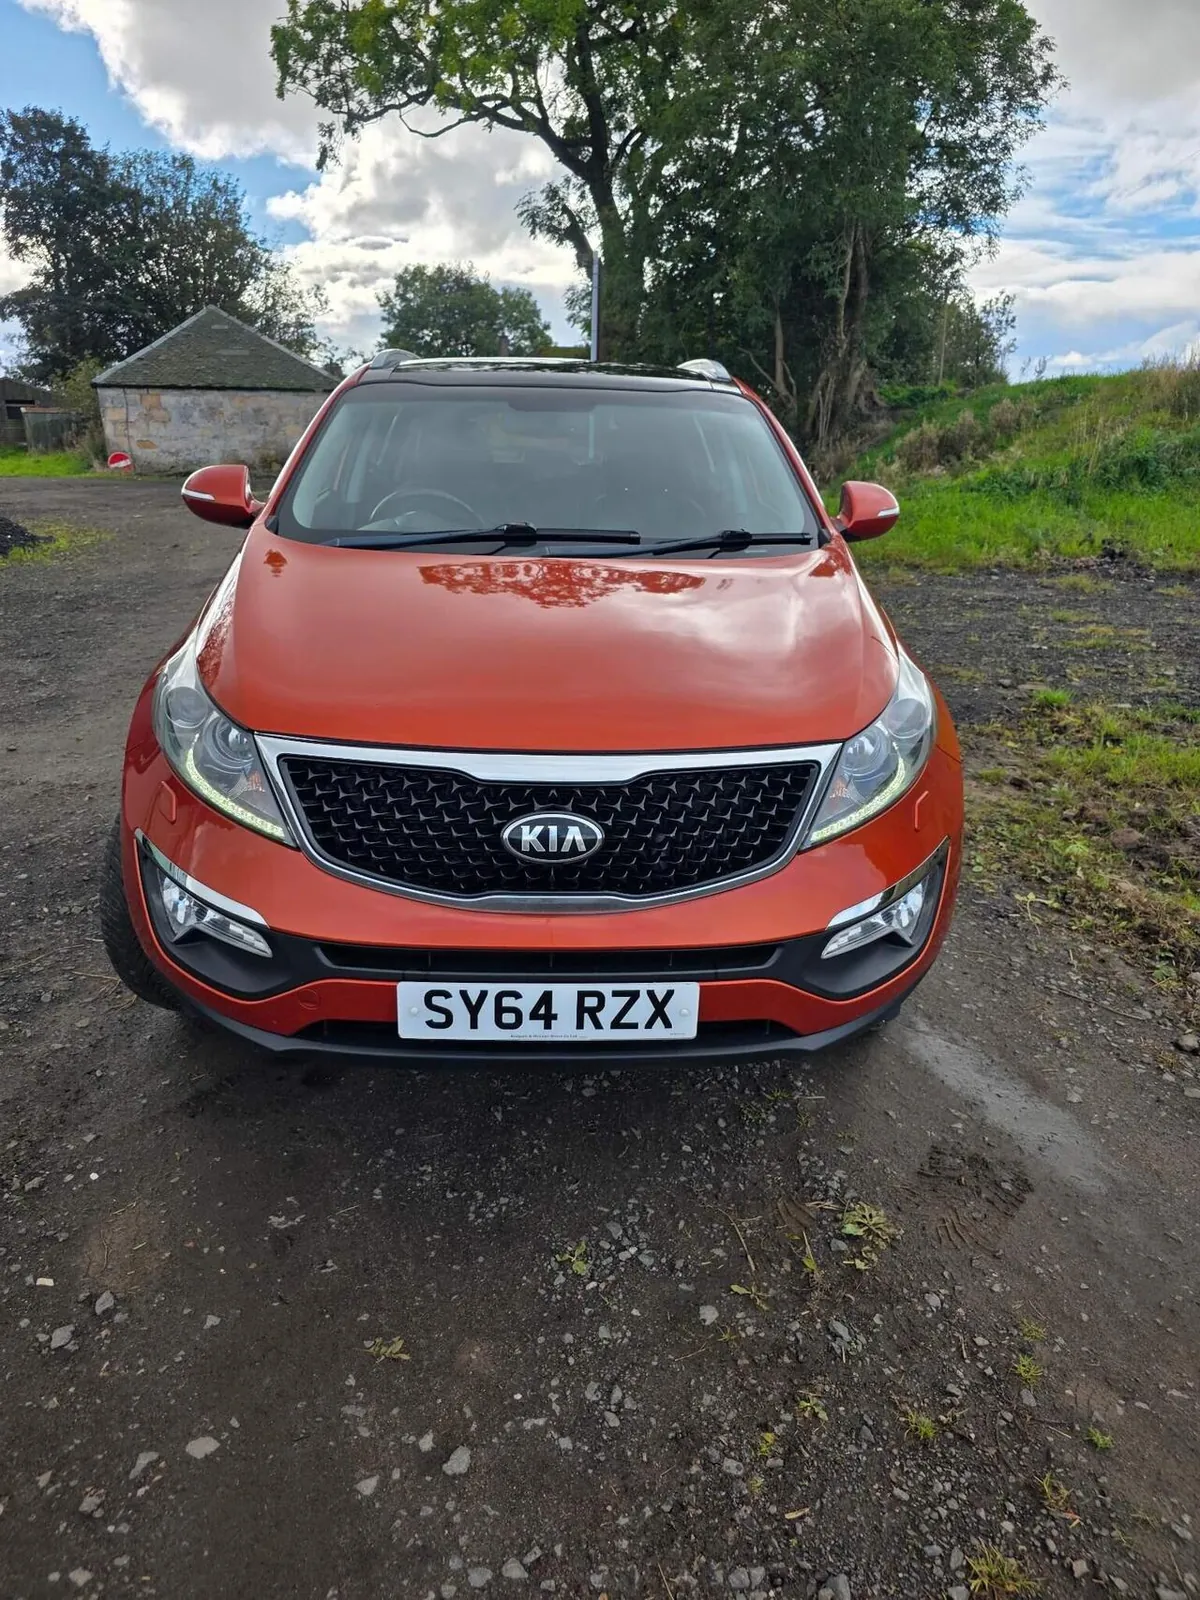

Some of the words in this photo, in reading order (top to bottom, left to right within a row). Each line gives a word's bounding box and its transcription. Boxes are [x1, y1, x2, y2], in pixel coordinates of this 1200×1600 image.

[520, 825, 587, 852] KIA
[423, 989, 558, 1031] SY64
[575, 989, 675, 1031] RZX
